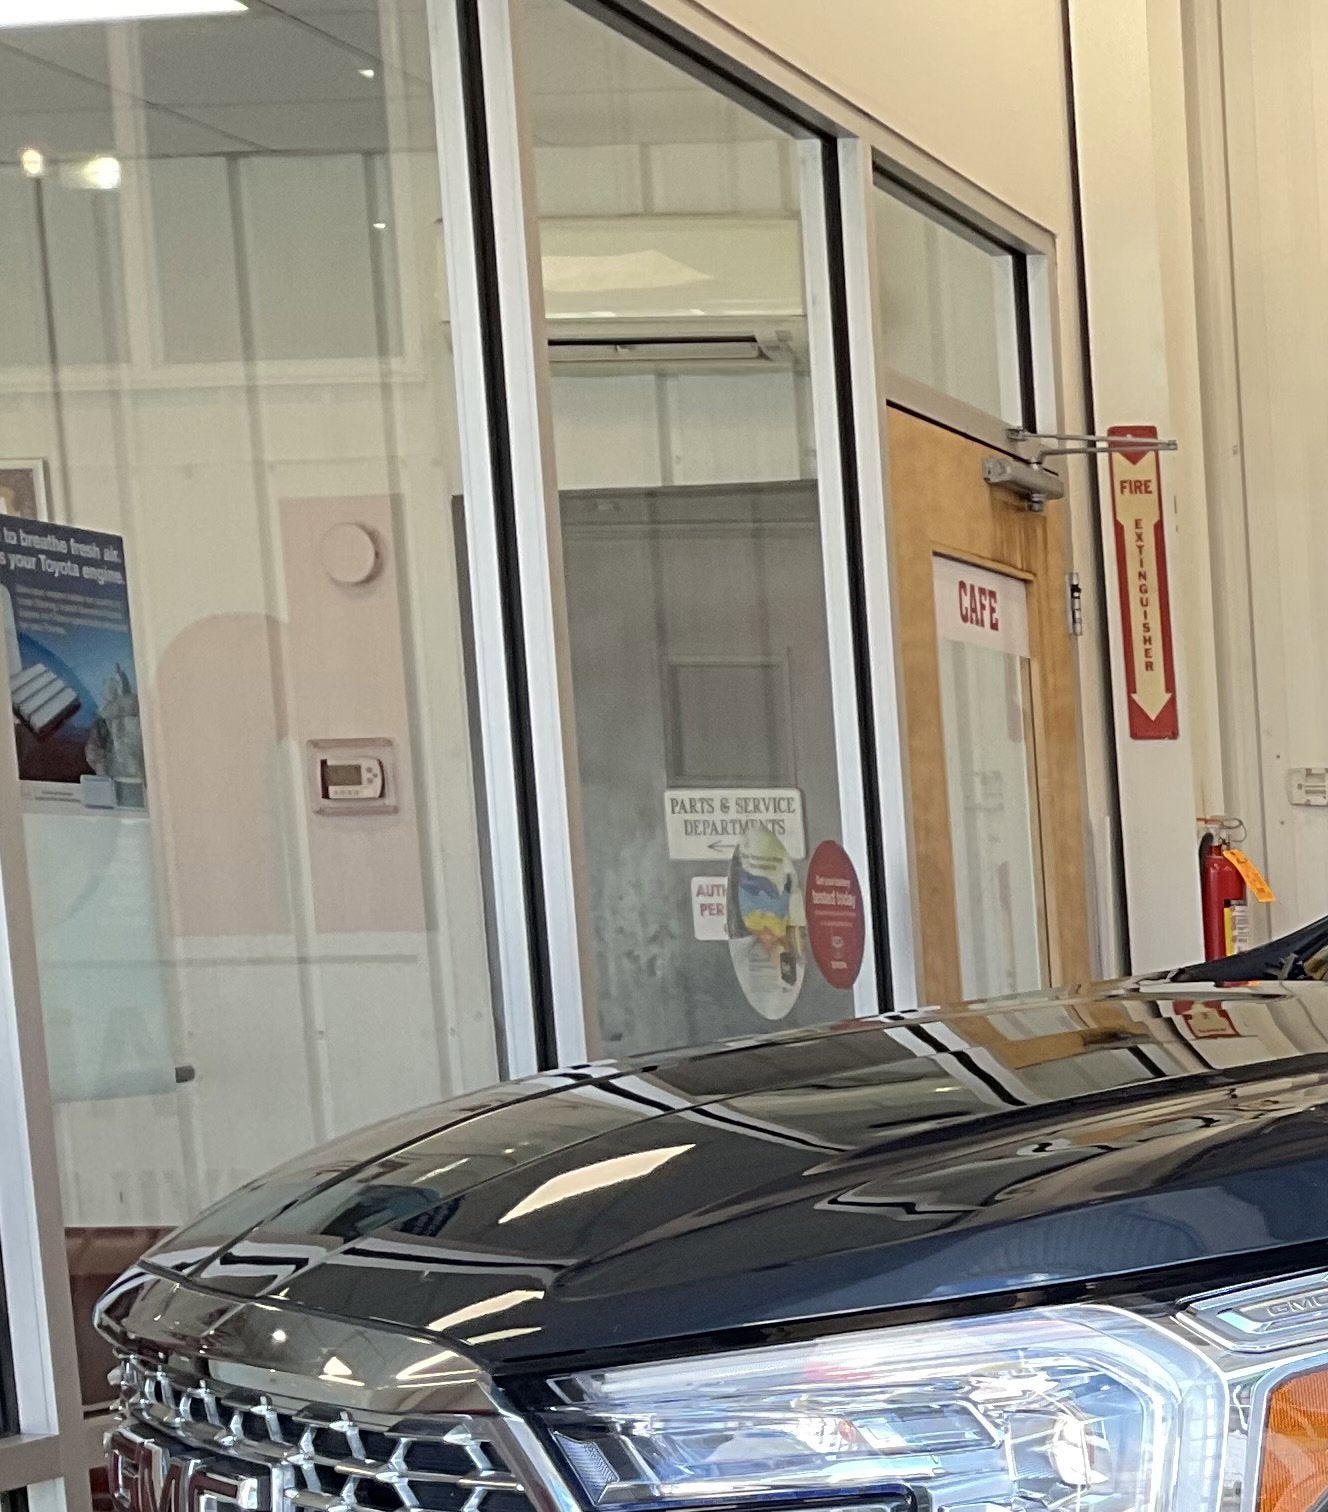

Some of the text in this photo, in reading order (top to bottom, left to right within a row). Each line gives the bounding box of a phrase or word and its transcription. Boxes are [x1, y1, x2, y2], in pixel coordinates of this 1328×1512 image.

[1120, 479, 1153, 496] FIRE
[19, 528, 68, 554] breathe
[70, 538, 101, 559] fresh
[7, 553, 37, 570] your
[38, 554, 80, 578] Toyota
[958, 580, 1000, 632] CAFE
[1134, 518, 1155, 672] EXTINGUISHER
[670, 797, 796, 814] PARTS & SERVICE
